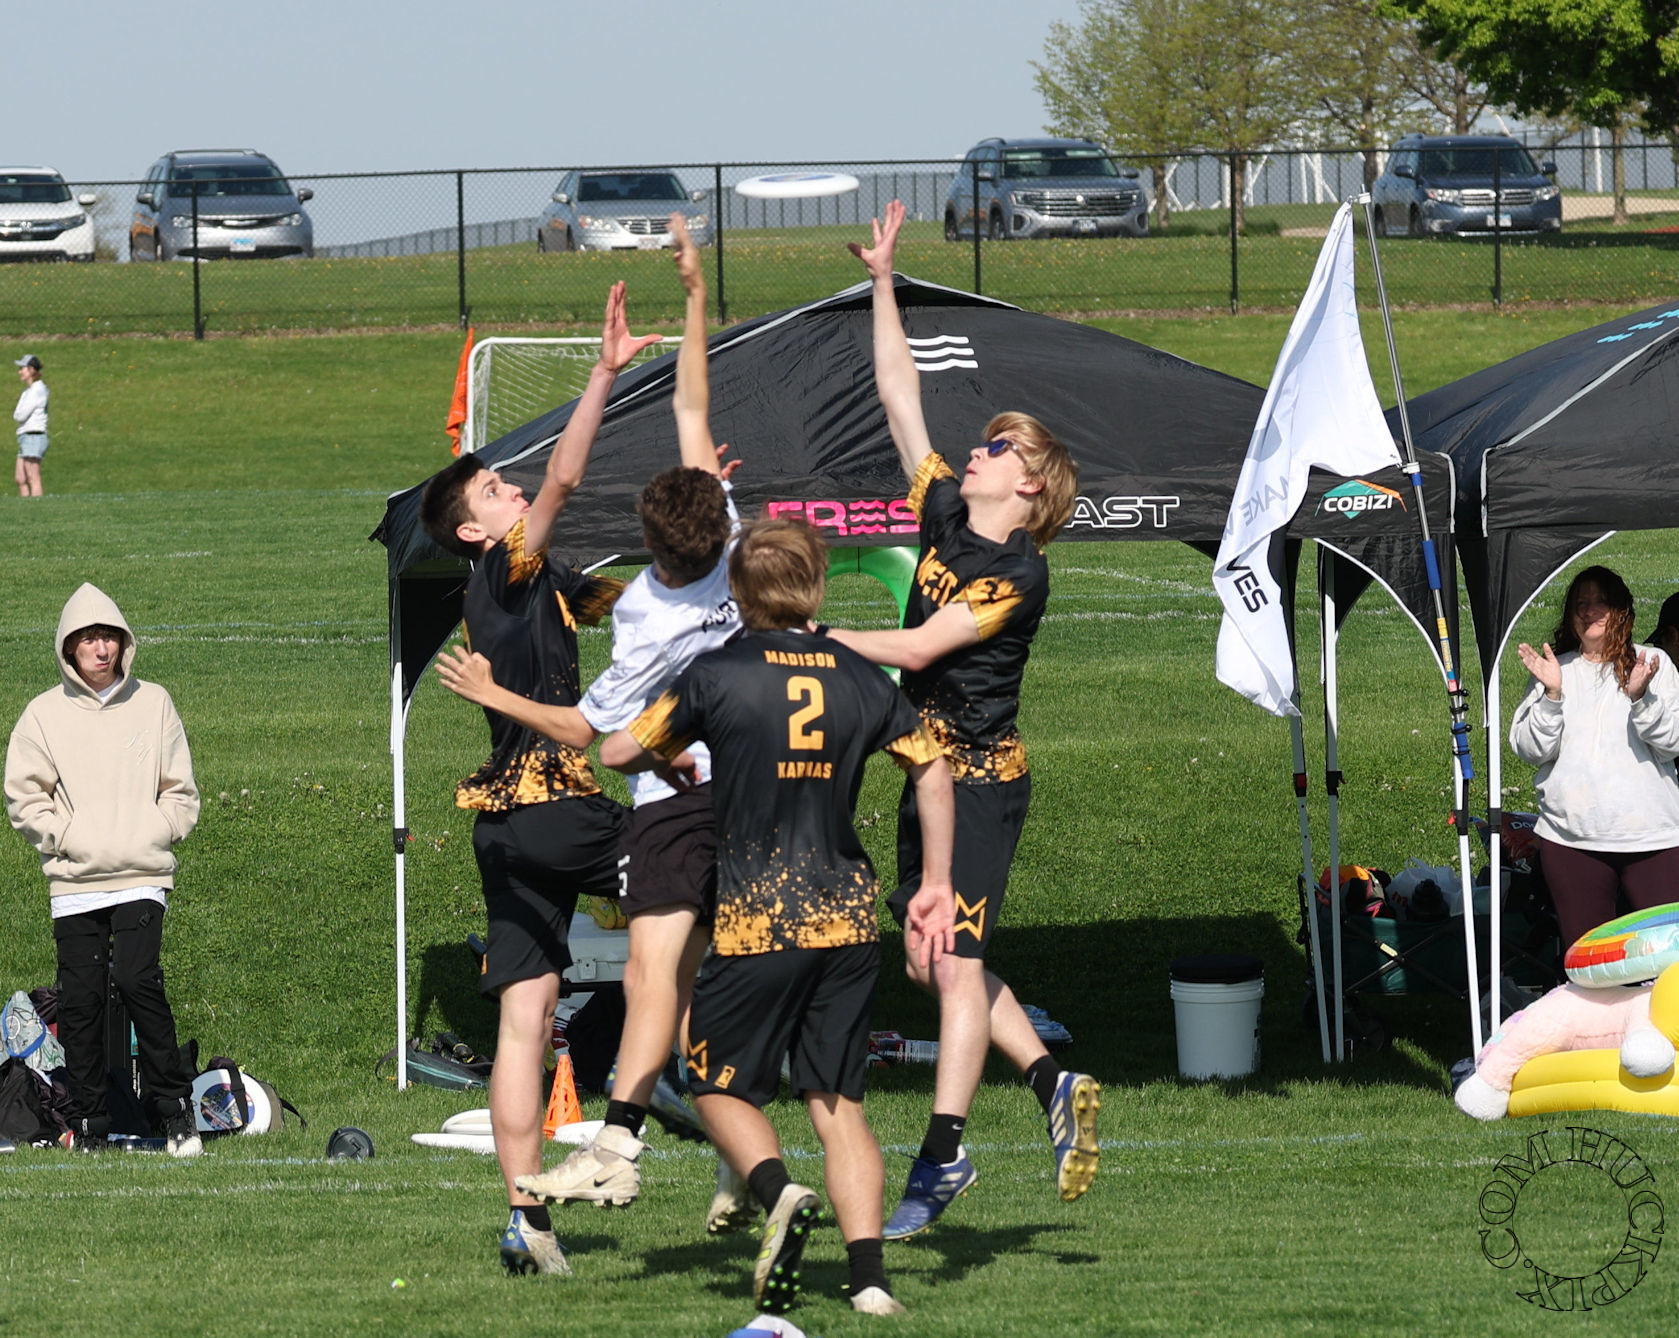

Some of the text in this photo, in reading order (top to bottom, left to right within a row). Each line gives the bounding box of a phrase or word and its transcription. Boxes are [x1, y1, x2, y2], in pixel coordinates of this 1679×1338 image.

[1063, 496, 1180, 528] AST
[1323, 494, 1393, 513] COBIZI
[764, 650, 837, 668] MADISON
[786, 675, 825, 750] 2
